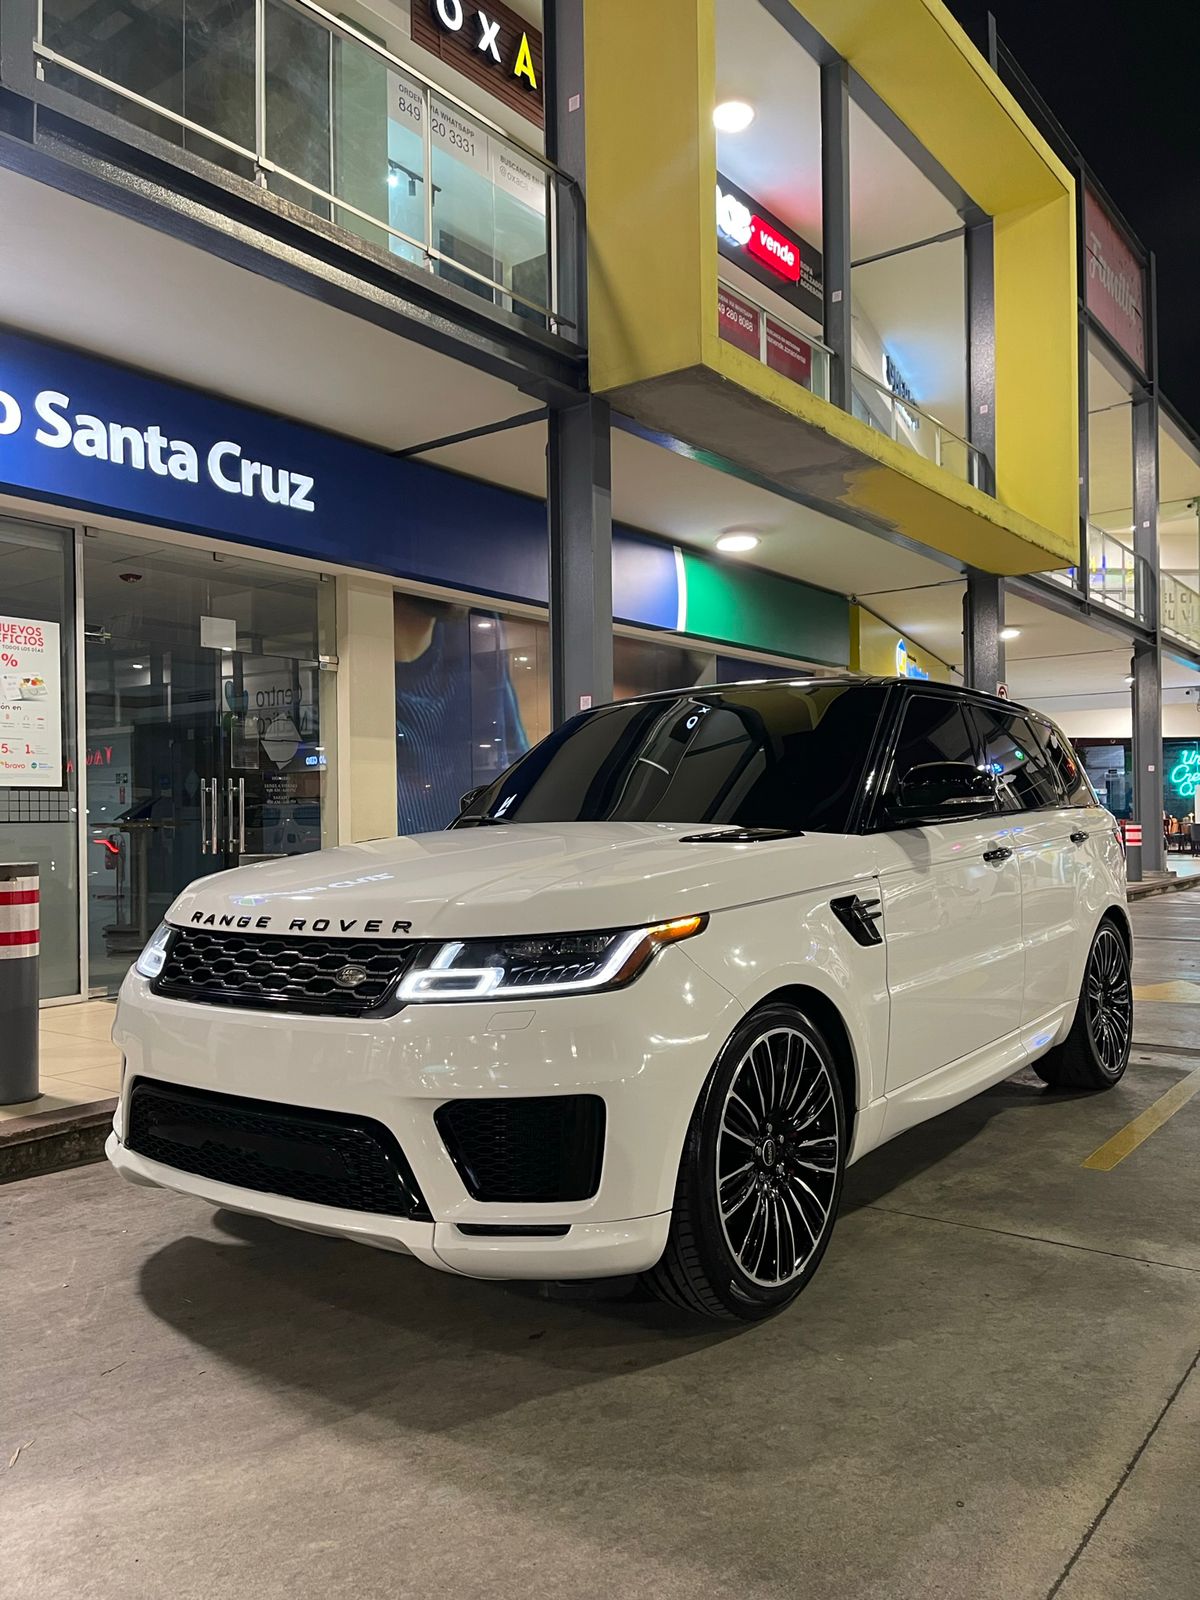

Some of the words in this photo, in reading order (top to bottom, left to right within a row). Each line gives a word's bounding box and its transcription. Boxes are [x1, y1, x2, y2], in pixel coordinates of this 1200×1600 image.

[436, 0, 537, 90] OXA
[399, 97, 421, 122] 849
[431, 118, 446, 138] 20
[449, 130, 475, 157] 3331
[440, 111, 475, 138] WHATSAPP
[760, 230, 795, 267] vende
[35, 391, 198, 482] Santa
[208, 441, 315, 512] Cruz
[0, 623, 42, 637] UEVOS
[0, 633, 44, 647] FICIOS
[4, 761, 26, 769] bravo
[191, 911, 271, 929] RANGE
[289, 918, 412, 934] ROVER
